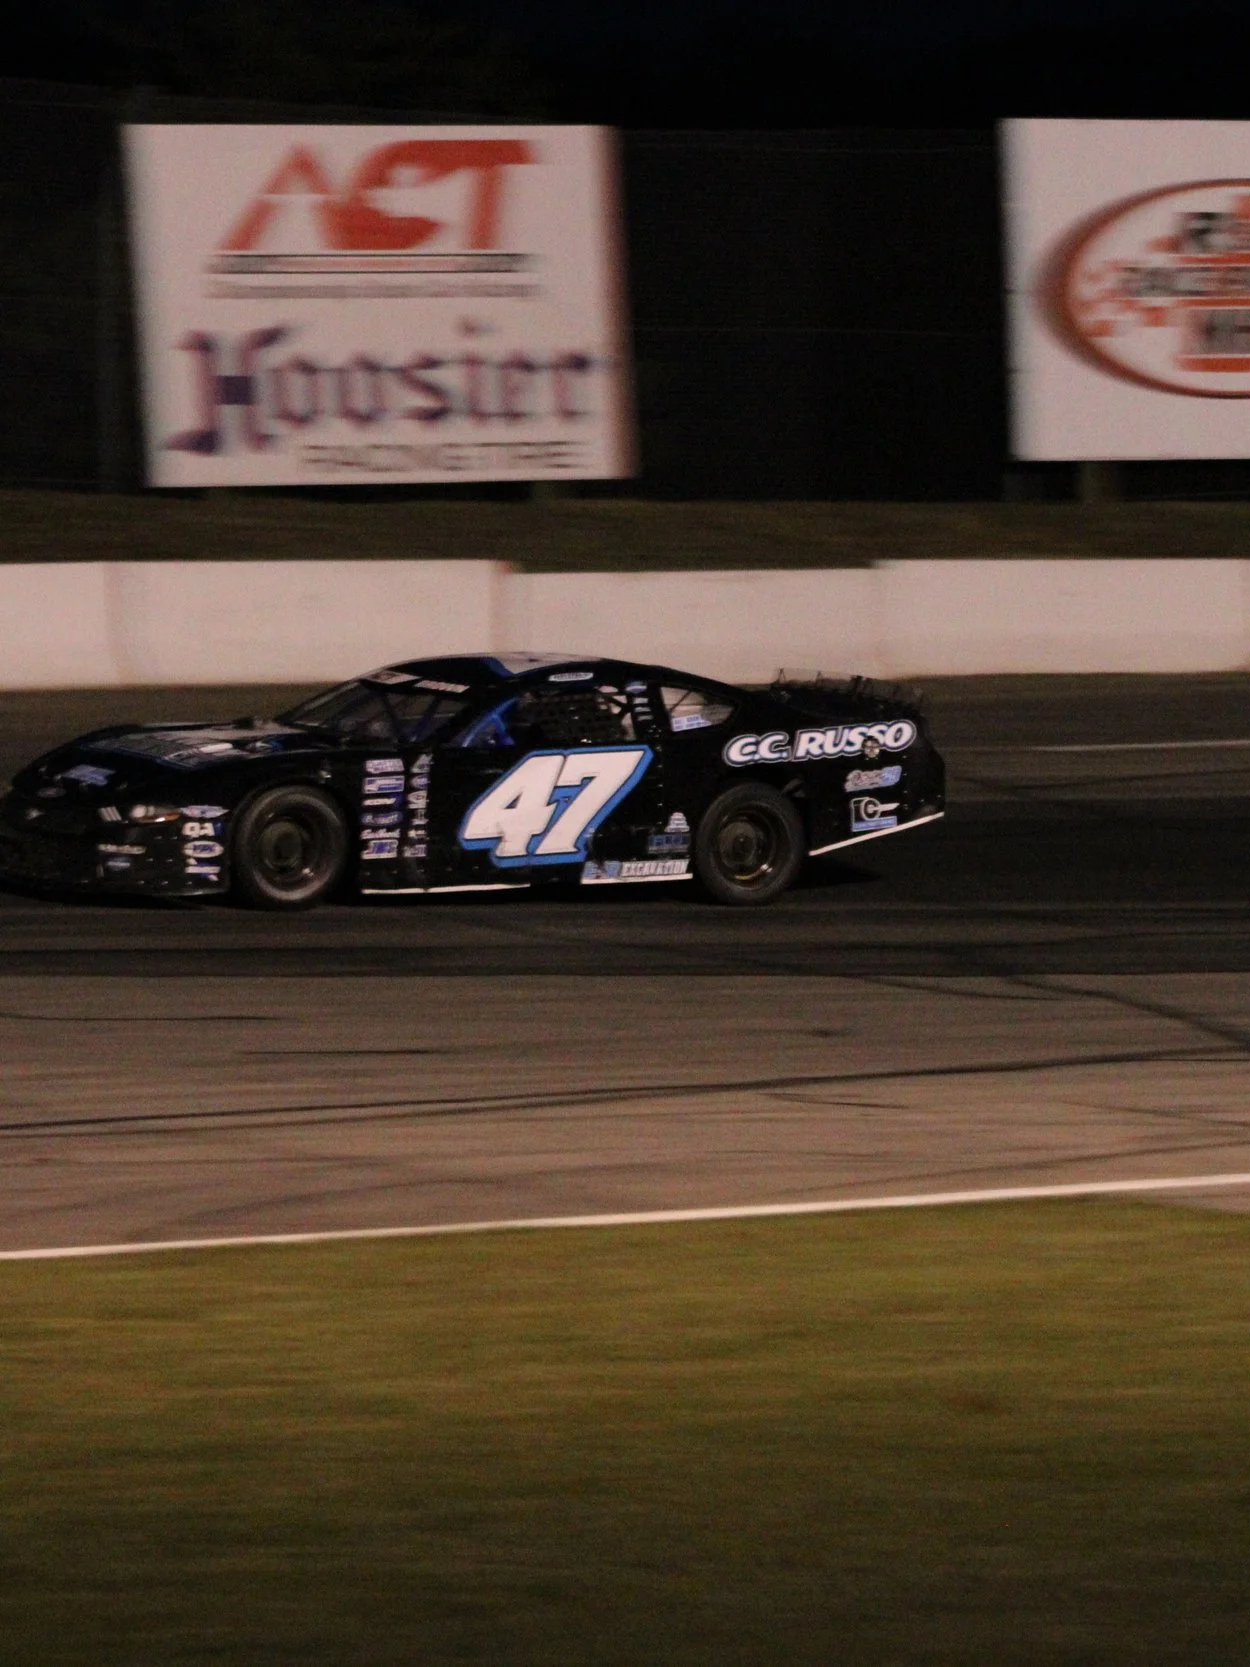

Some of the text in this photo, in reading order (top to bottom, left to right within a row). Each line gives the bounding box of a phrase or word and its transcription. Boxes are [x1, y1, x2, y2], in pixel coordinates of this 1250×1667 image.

[211, 138, 538, 250] ACT
[164, 322, 602, 456] Hoosier
[792, 719, 917, 762] RUSSO
[457, 744, 654, 868] 47
